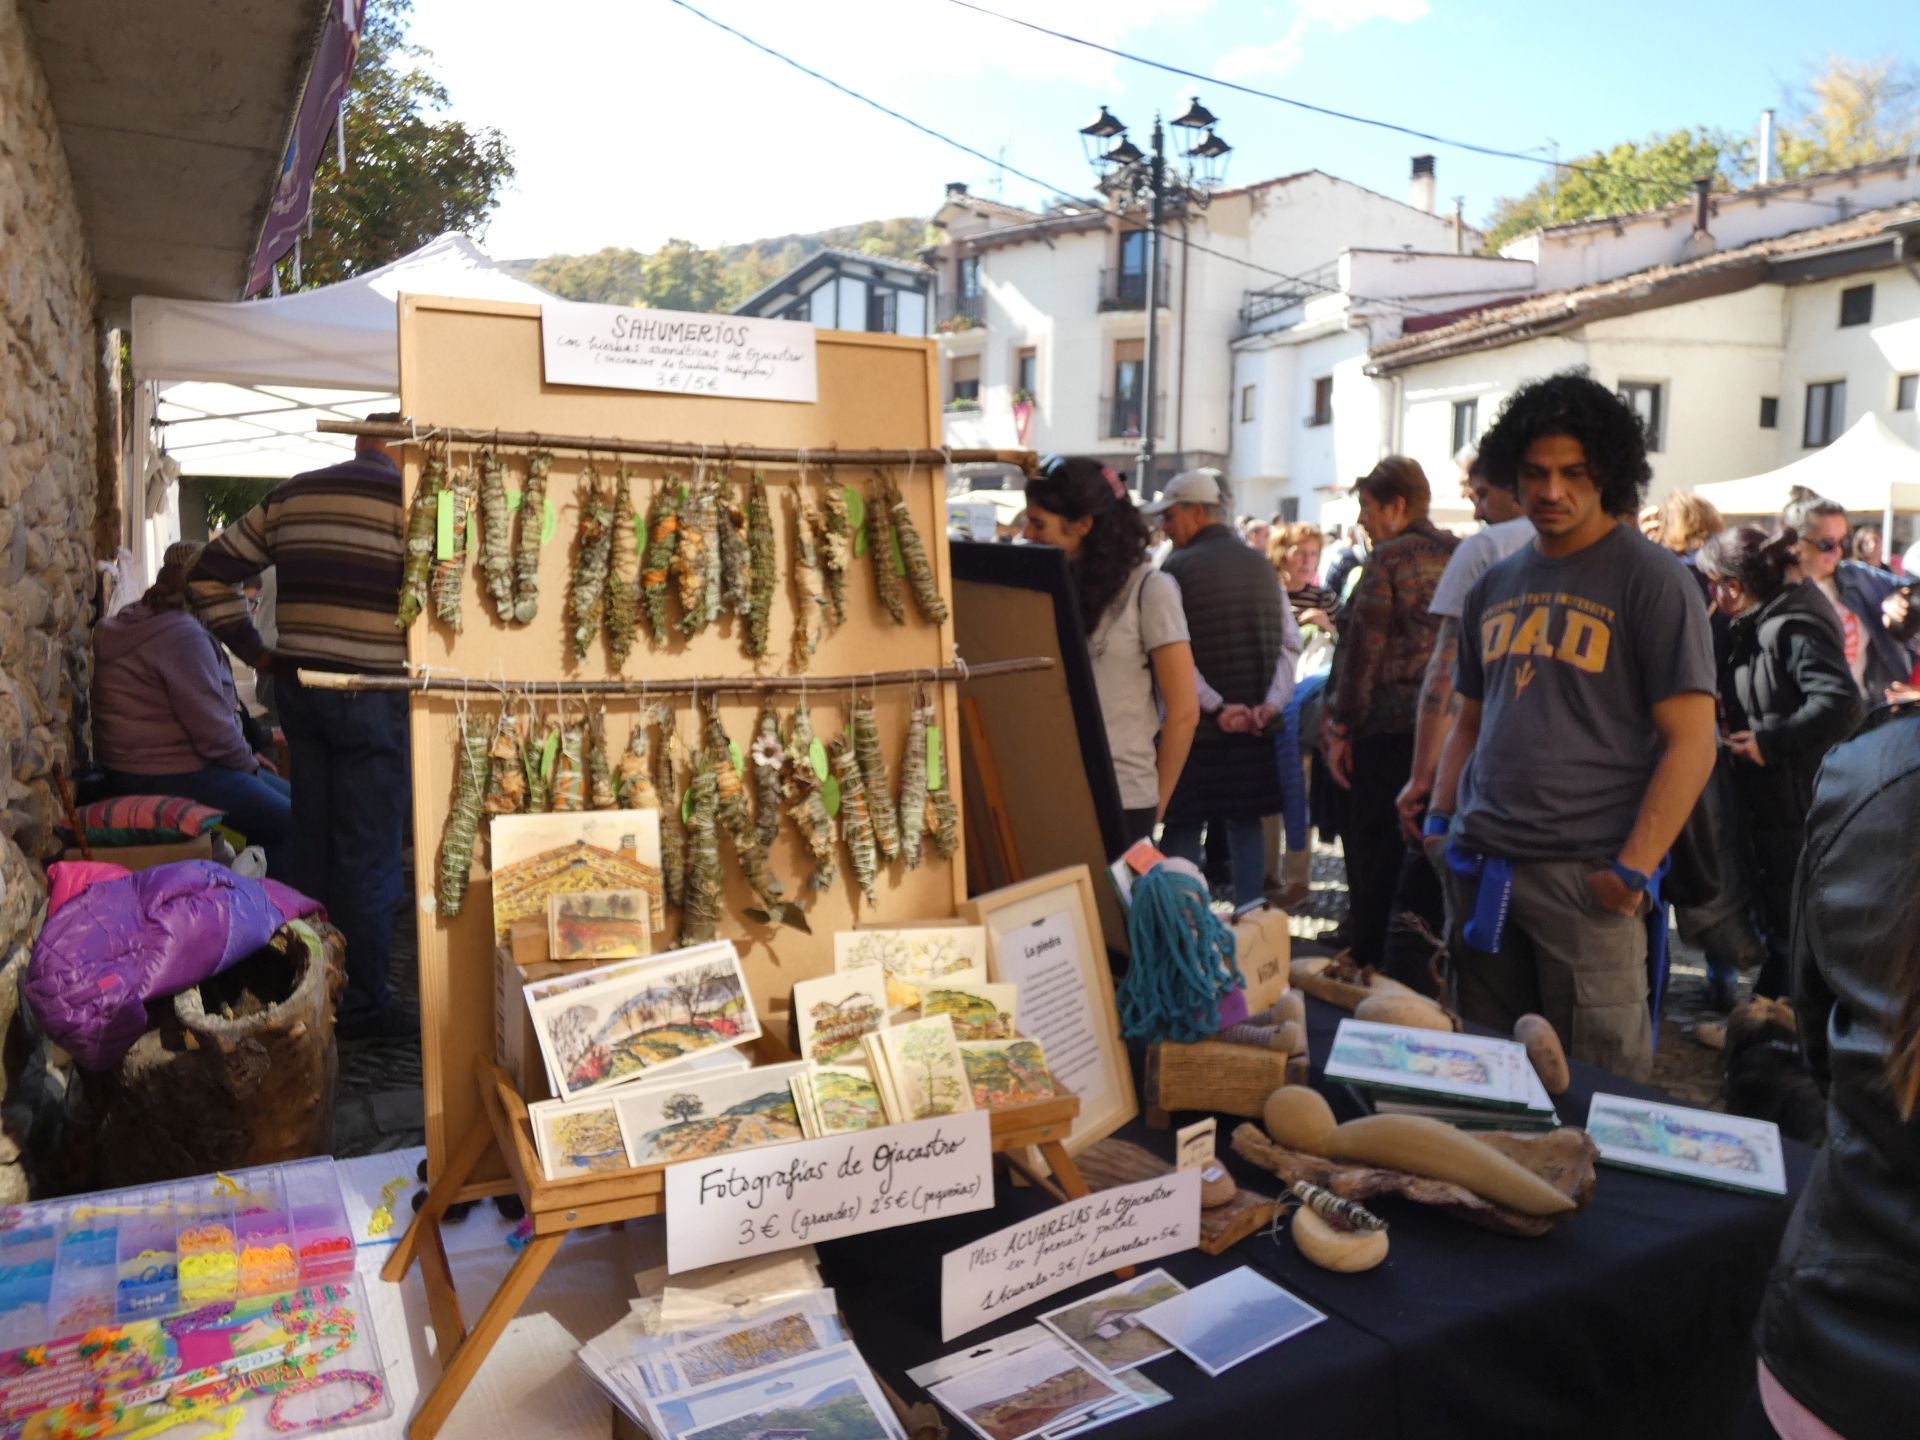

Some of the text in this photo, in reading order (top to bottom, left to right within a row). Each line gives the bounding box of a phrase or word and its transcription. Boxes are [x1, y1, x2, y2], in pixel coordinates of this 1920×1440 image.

[727, 346, 742, 361] de
[1481, 606, 1612, 674] DAD
[1024, 943, 1036, 959] La
[699, 1128, 966, 1209] Fotografías de Ojacastro
[1003, 1205, 1093, 1258] ACUARELAS
[1095, 1199, 1112, 1220] de
